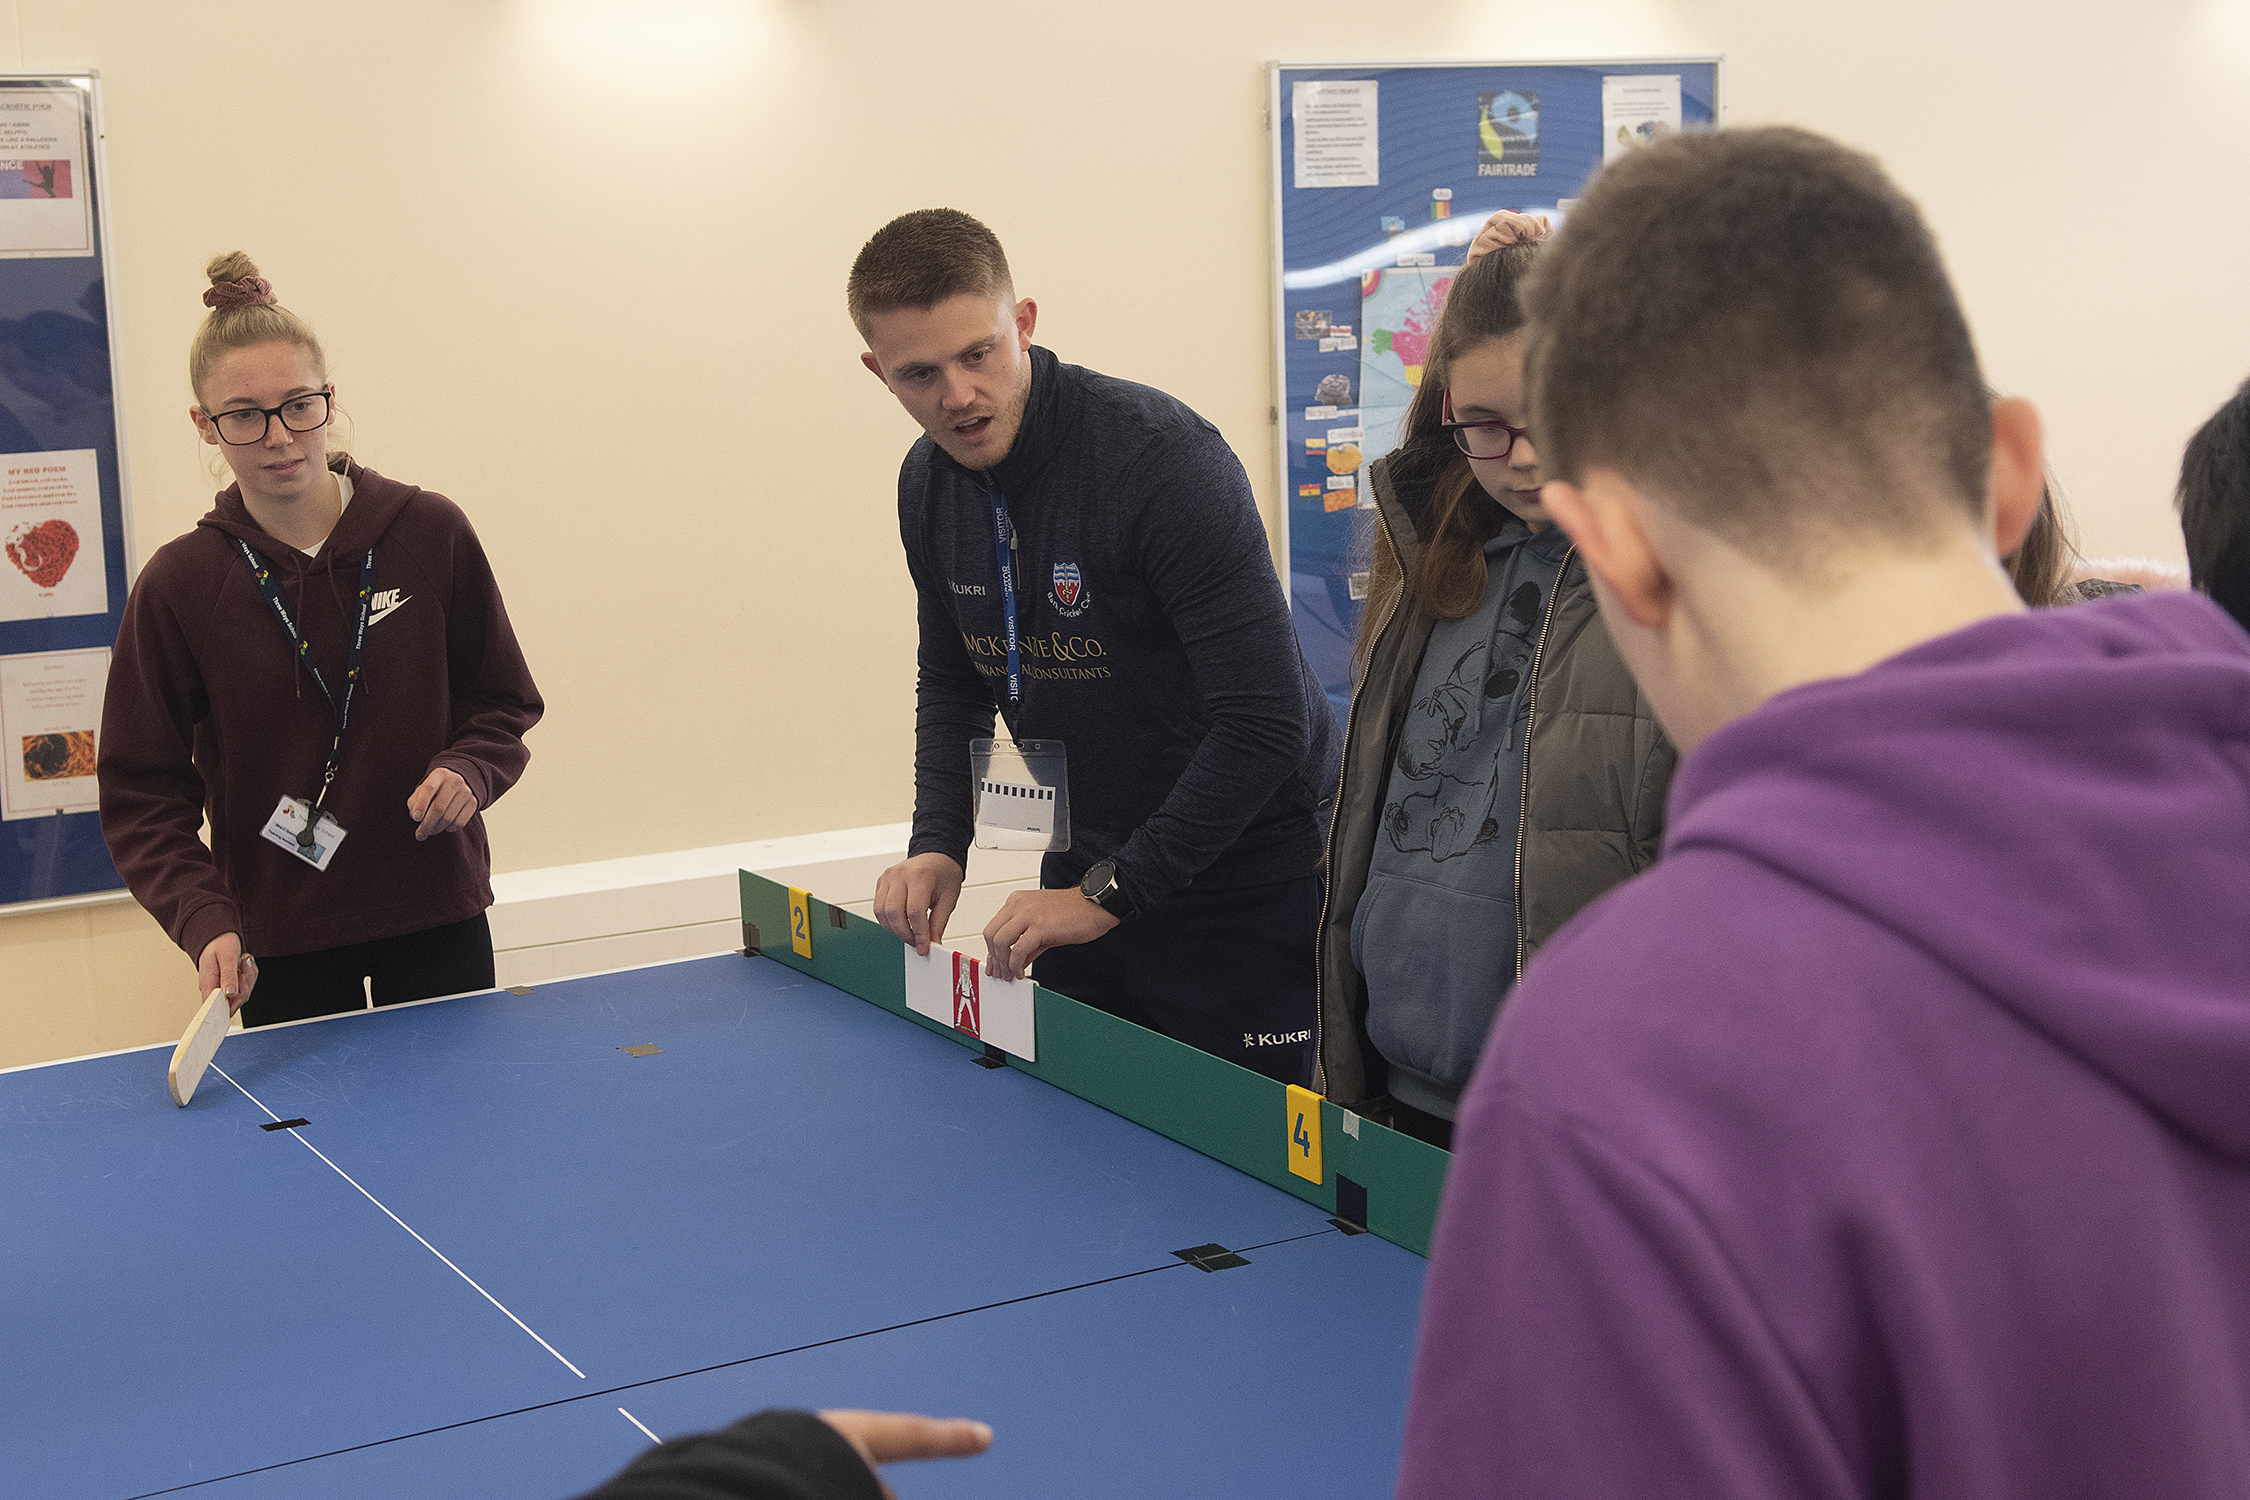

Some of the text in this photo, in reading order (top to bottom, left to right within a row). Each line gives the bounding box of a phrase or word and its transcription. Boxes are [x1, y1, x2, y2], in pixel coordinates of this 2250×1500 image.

[0, 160, 24, 171] NCE
[1478, 163, 1538, 177] FAIRTRADE
[995, 507, 1006, 543] VISITOR
[247, 553, 260, 569] School
[371, 588, 400, 611] NIKE
[272, 596, 283, 611] Three
[280, 609, 290, 623] Ways
[1059, 607, 1083, 618] Cricket
[357, 621, 365, 635] Ways
[1008, 615, 1017, 651] VISITOR
[355, 635, 363, 650] Three
[974, 661, 1033, 677] FINANAL
[346, 683, 354, 701] School
[794, 905, 806, 940] 2
[1257, 1028, 1311, 1047] KUKRI
[1293, 1112, 1311, 1158] 4
